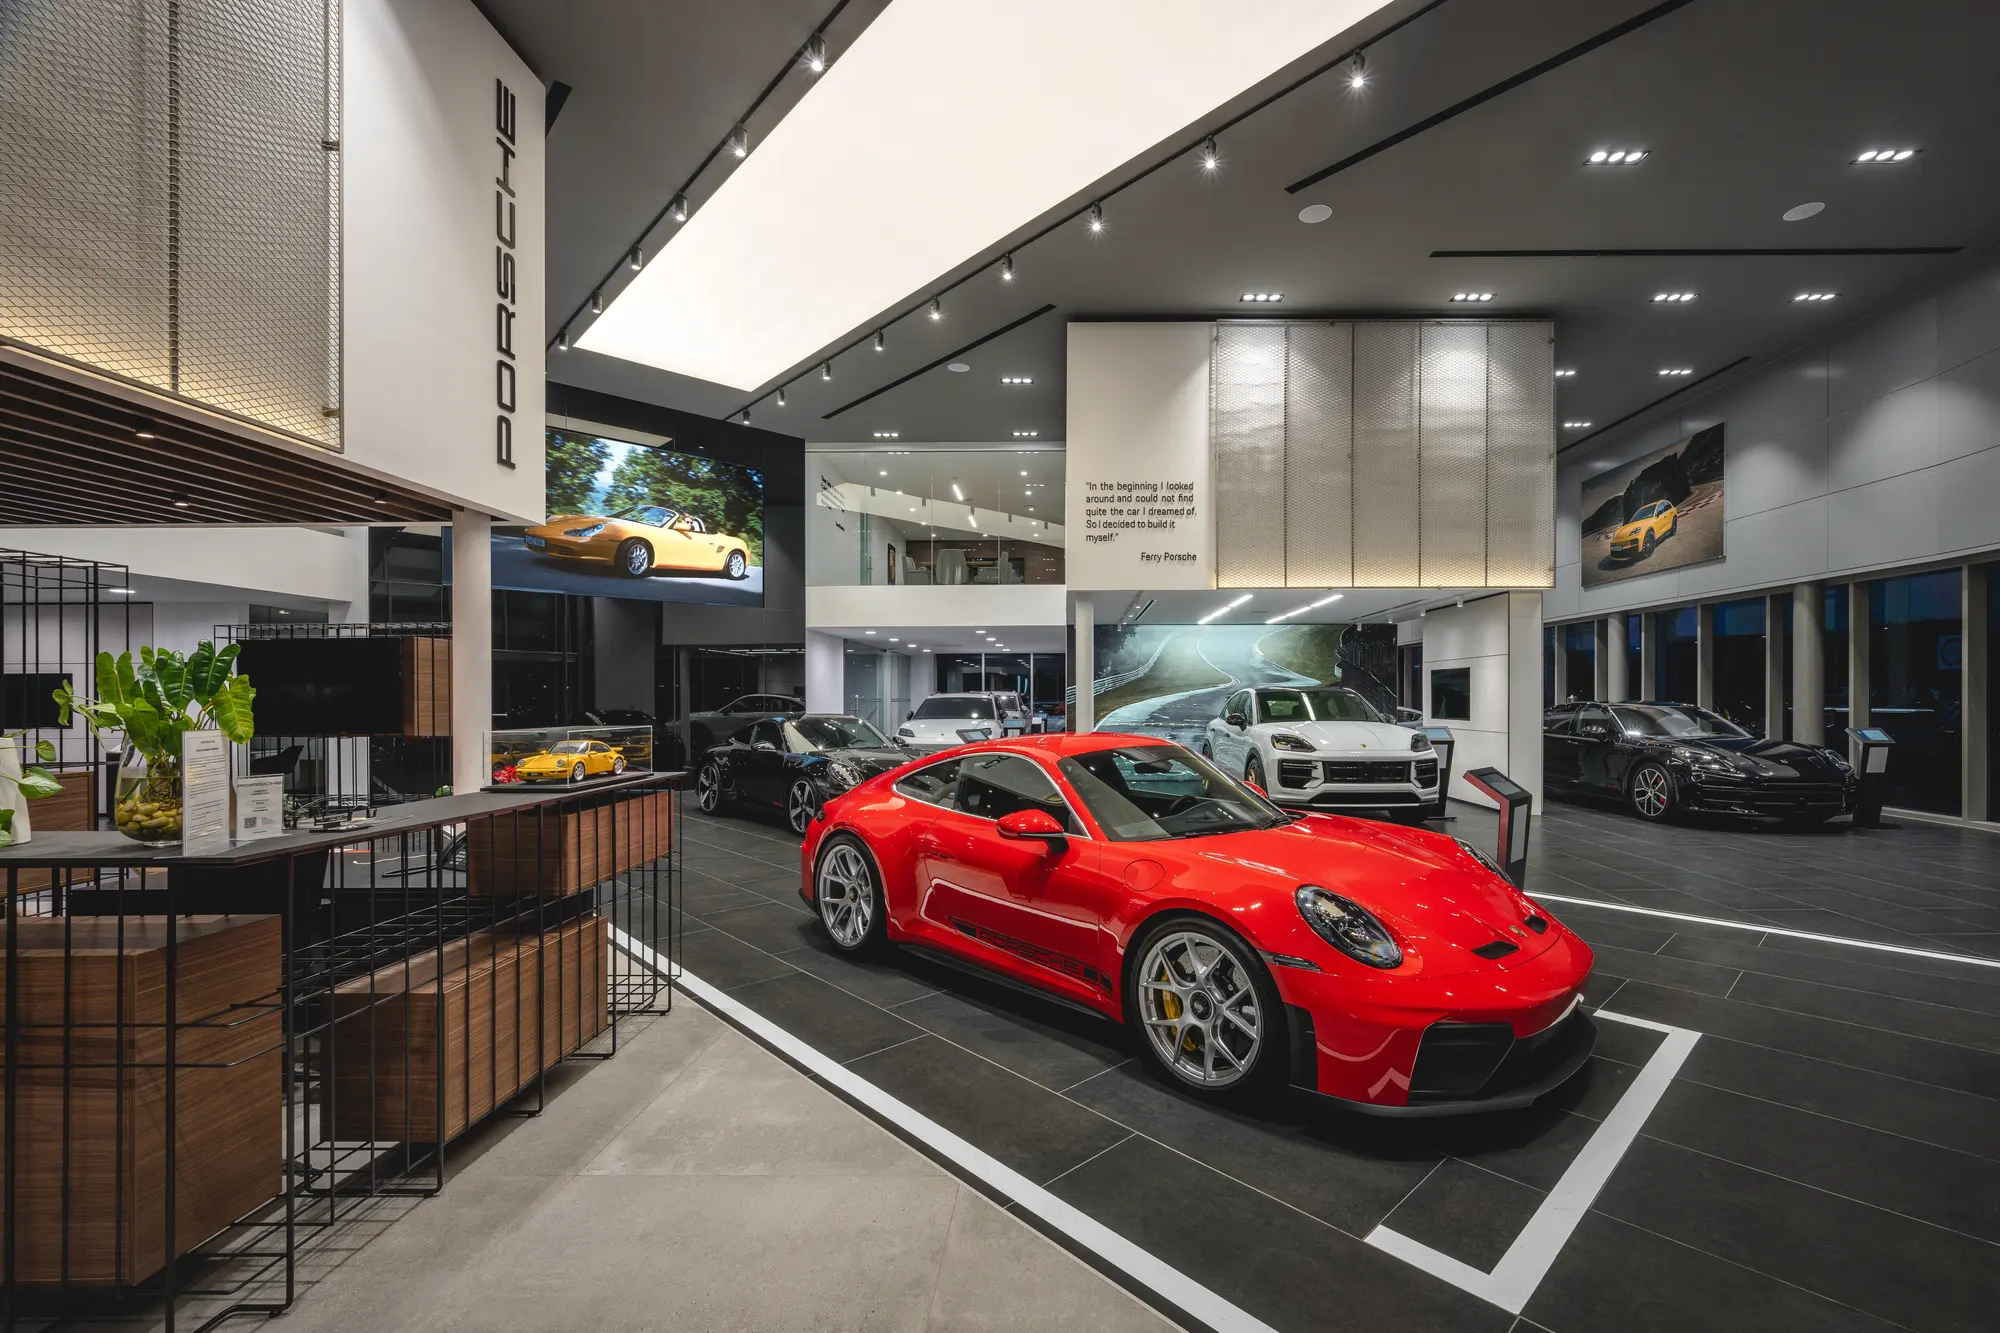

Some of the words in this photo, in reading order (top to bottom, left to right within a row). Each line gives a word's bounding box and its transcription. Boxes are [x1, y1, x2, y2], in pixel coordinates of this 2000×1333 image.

[496, 78, 516, 470] PORSCHE
[1100, 481, 1114, 490] the
[1117, 481, 1158, 492] beginning
[1166, 481, 1194, 490] looked
[1085, 494, 1115, 503] around
[1117, 493, 1133, 503] and
[1135, 493, 1158, 503] could
[1161, 494, 1175, 503] not
[1178, 493, 1194, 503] find
[1085, 507, 1107, 518] quite
[1110, 507, 1124, 516] the
[1126, 508, 1140, 516] car
[1148, 506, 1185, 516] dreamed
[1086, 519, 1097, 529] So
[1102, 519, 1136, 529] decided
[1137, 520, 1146, 529] to
[1147, 519, 1168, 529] build
[1169, 519, 1176, 529] it
[1141, 552, 1162, 563] Ferry
[1163, 552, 1197, 561] Porsche
[980, 929, 1079, 972] PORSCHE
